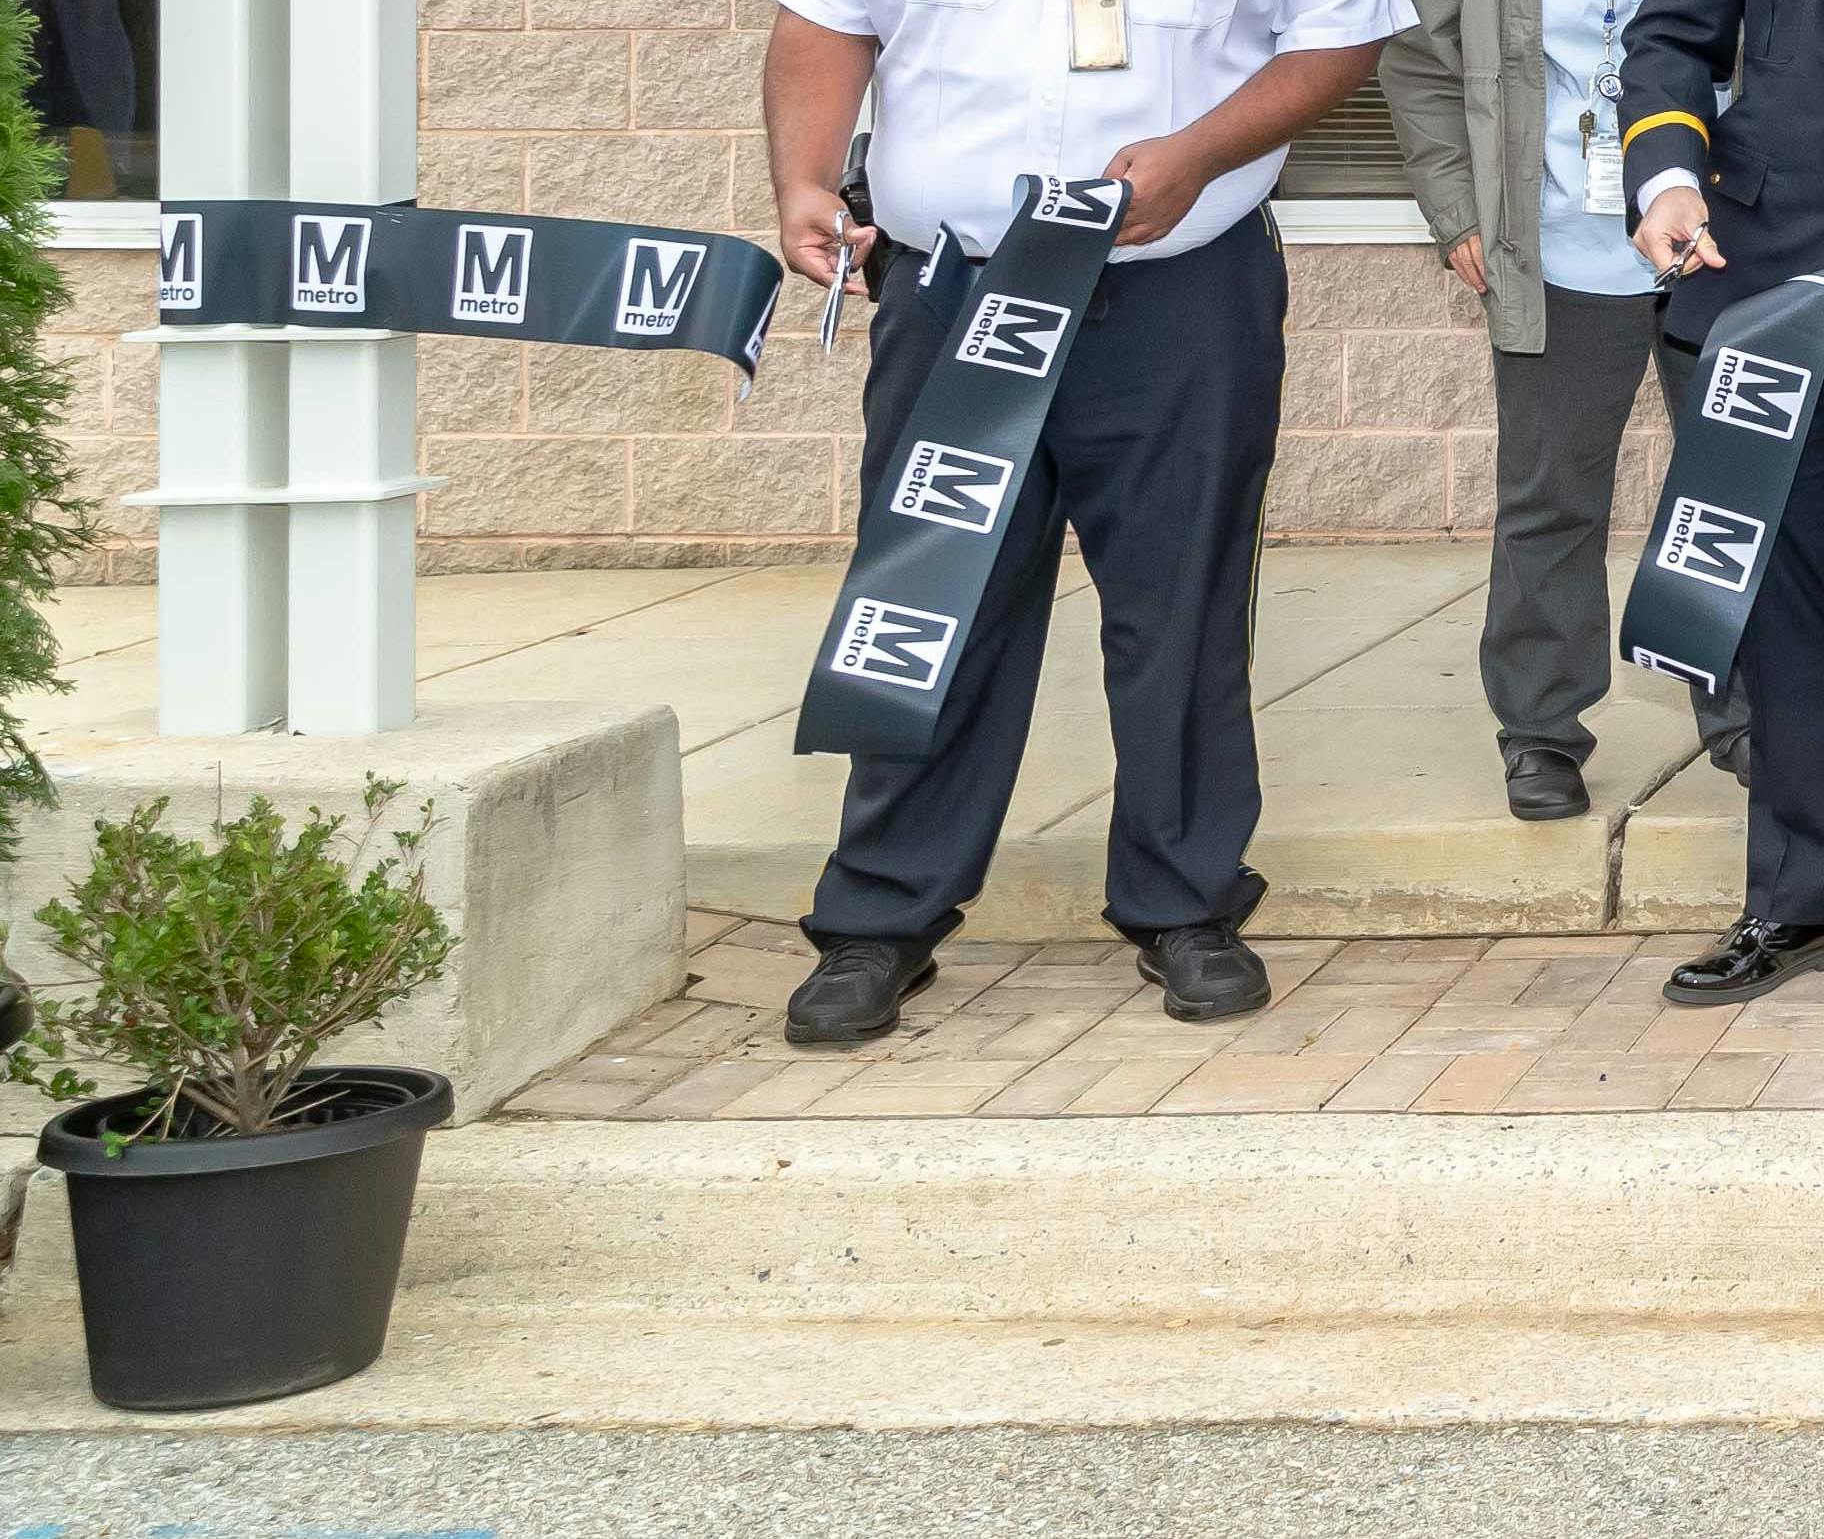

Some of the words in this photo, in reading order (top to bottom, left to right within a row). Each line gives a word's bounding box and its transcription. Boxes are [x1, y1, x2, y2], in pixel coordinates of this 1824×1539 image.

[1042, 174, 1061, 216] etro
[299, 222, 365, 285] M
[462, 231, 525, 296] M
[627, 245, 701, 310] M
[160, 286, 195, 303] etro
[296, 287, 358, 306] metro
[459, 296, 520, 317] metro
[623, 307, 676, 329] metro
[966, 299, 1002, 357] metro
[982, 302, 1066, 371] M
[1711, 353, 1739, 414] metro
[1728, 359, 1802, 433] M
[902, 447, 936, 509] metro
[920, 452, 1006, 527] M
[1666, 503, 1695, 564] metro
[1683, 509, 1756, 584] M
[843, 605, 876, 668] metro
[862, 610, 949, 683] M
